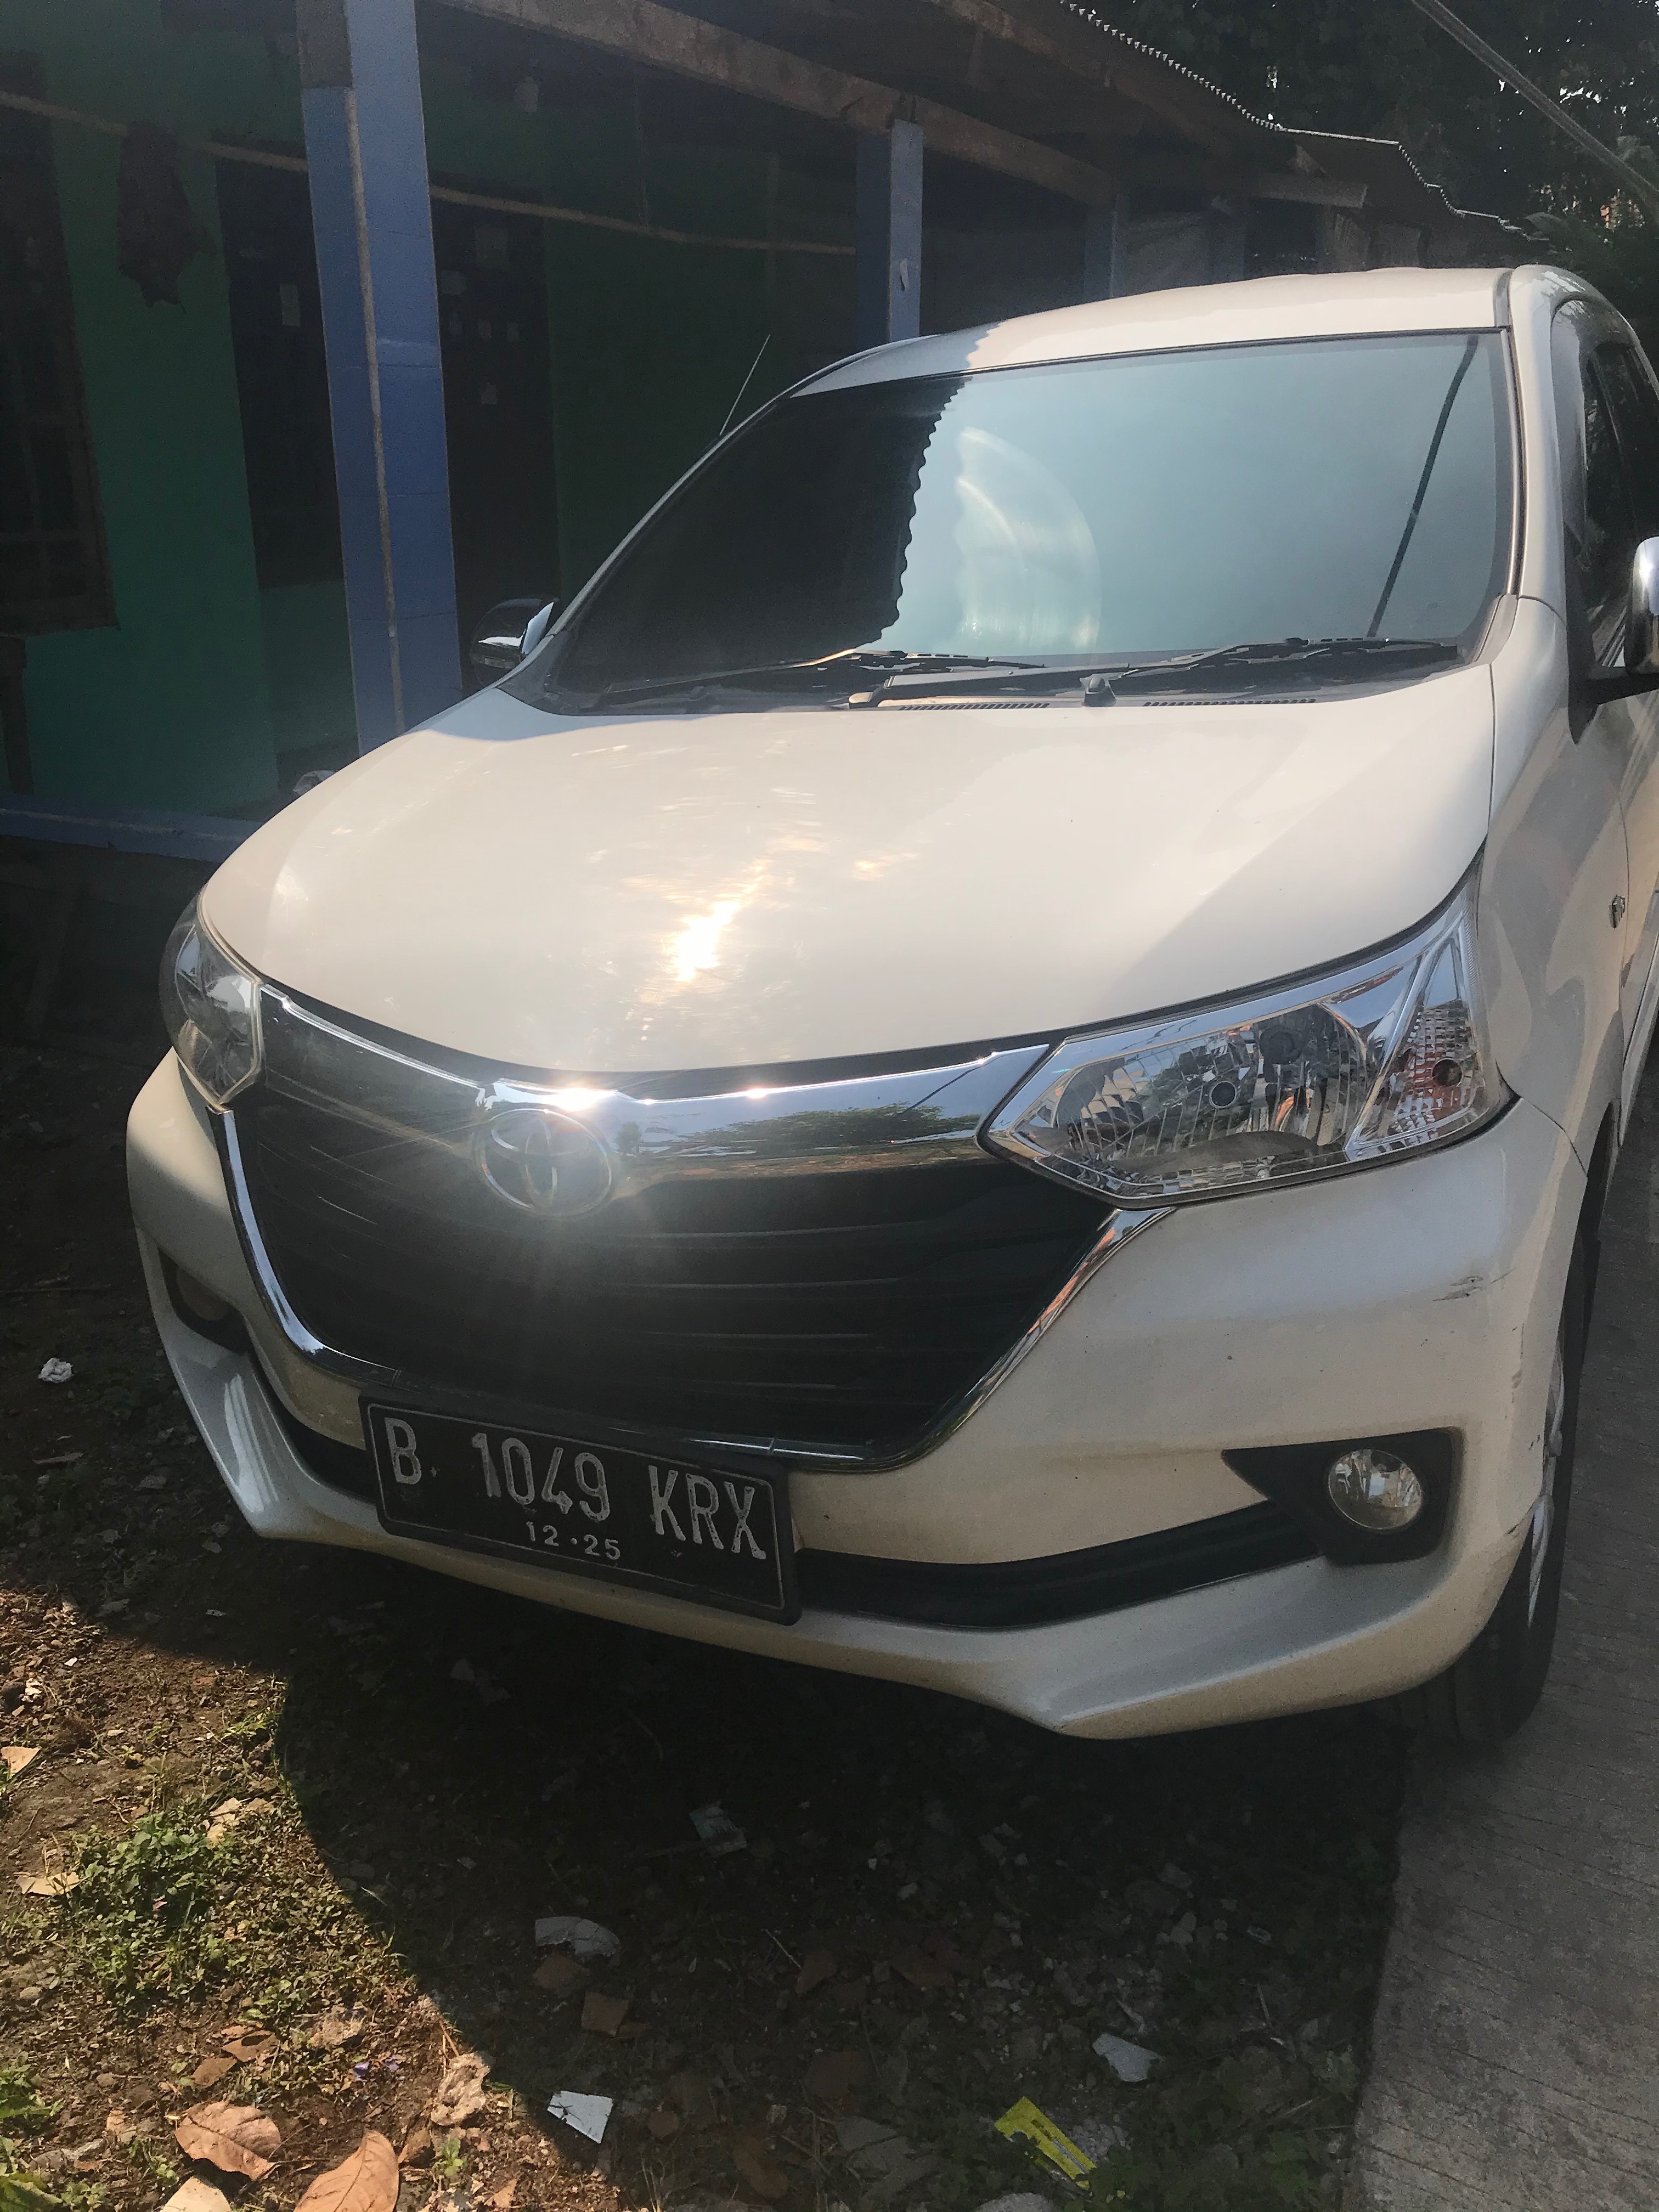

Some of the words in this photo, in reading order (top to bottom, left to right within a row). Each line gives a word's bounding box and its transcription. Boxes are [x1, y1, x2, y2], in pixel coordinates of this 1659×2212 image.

[385, 1418, 422, 1485] B
[472, 1432, 611, 1521] 1049
[649, 1465, 766, 1560] KRX
